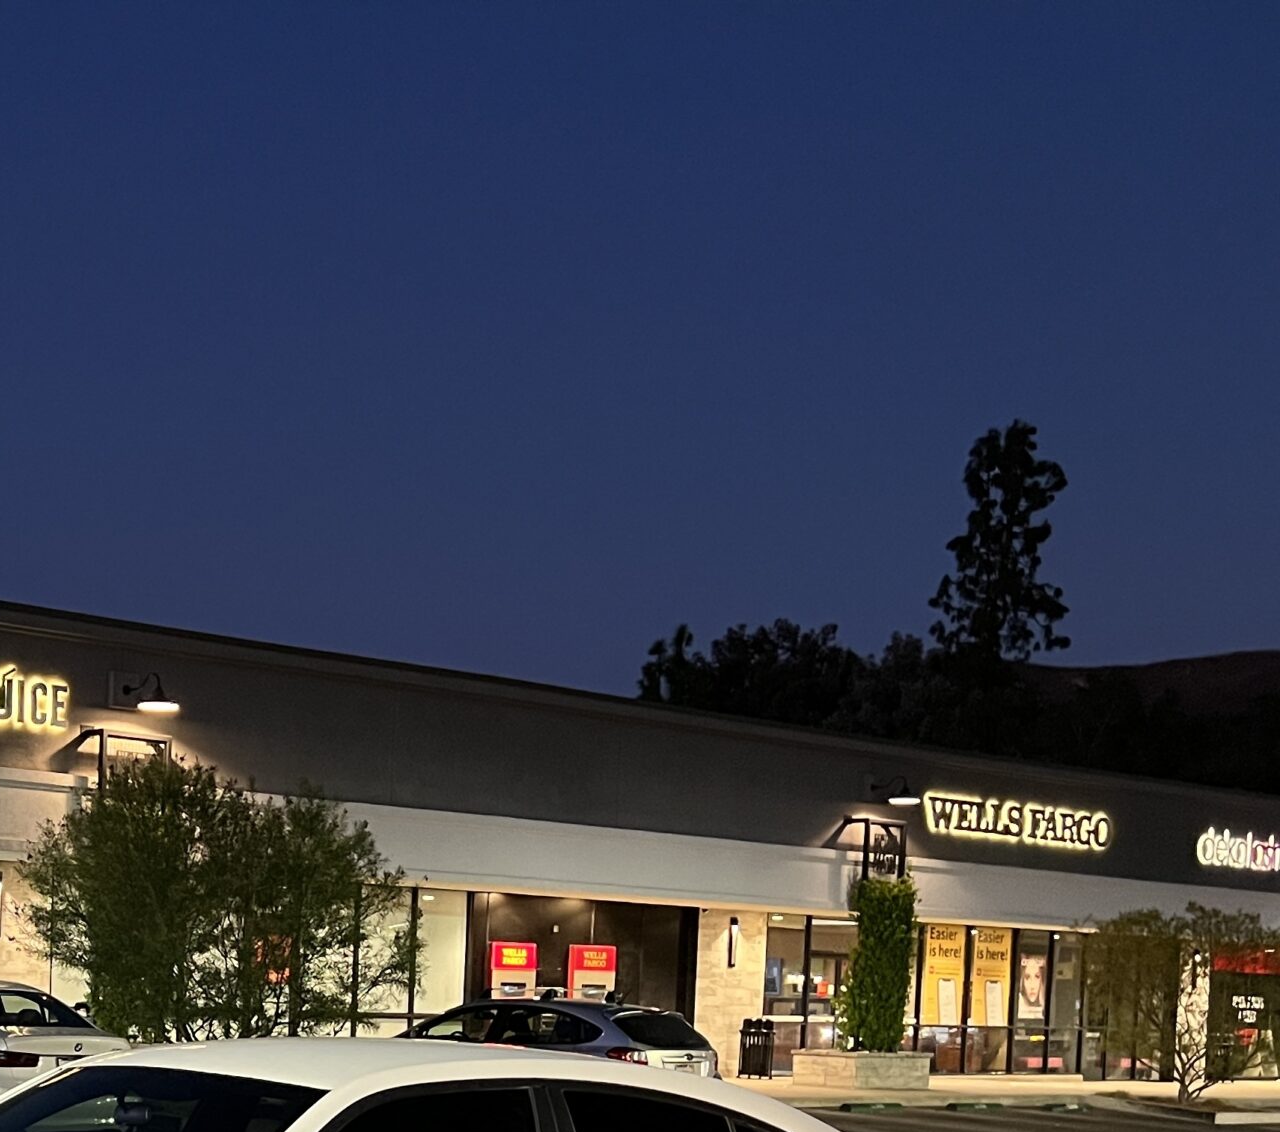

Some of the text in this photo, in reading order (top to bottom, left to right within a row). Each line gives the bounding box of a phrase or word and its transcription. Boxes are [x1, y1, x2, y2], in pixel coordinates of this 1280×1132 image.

[927, 796, 1113, 848] WELLS FARGO
[929, 927, 959, 941] Easier
[977, 930, 1006, 944] Easier
[583, 951, 607, 960] WELLS
[928, 943, 962, 959] is here!
[976, 946, 1008, 961] is here!
